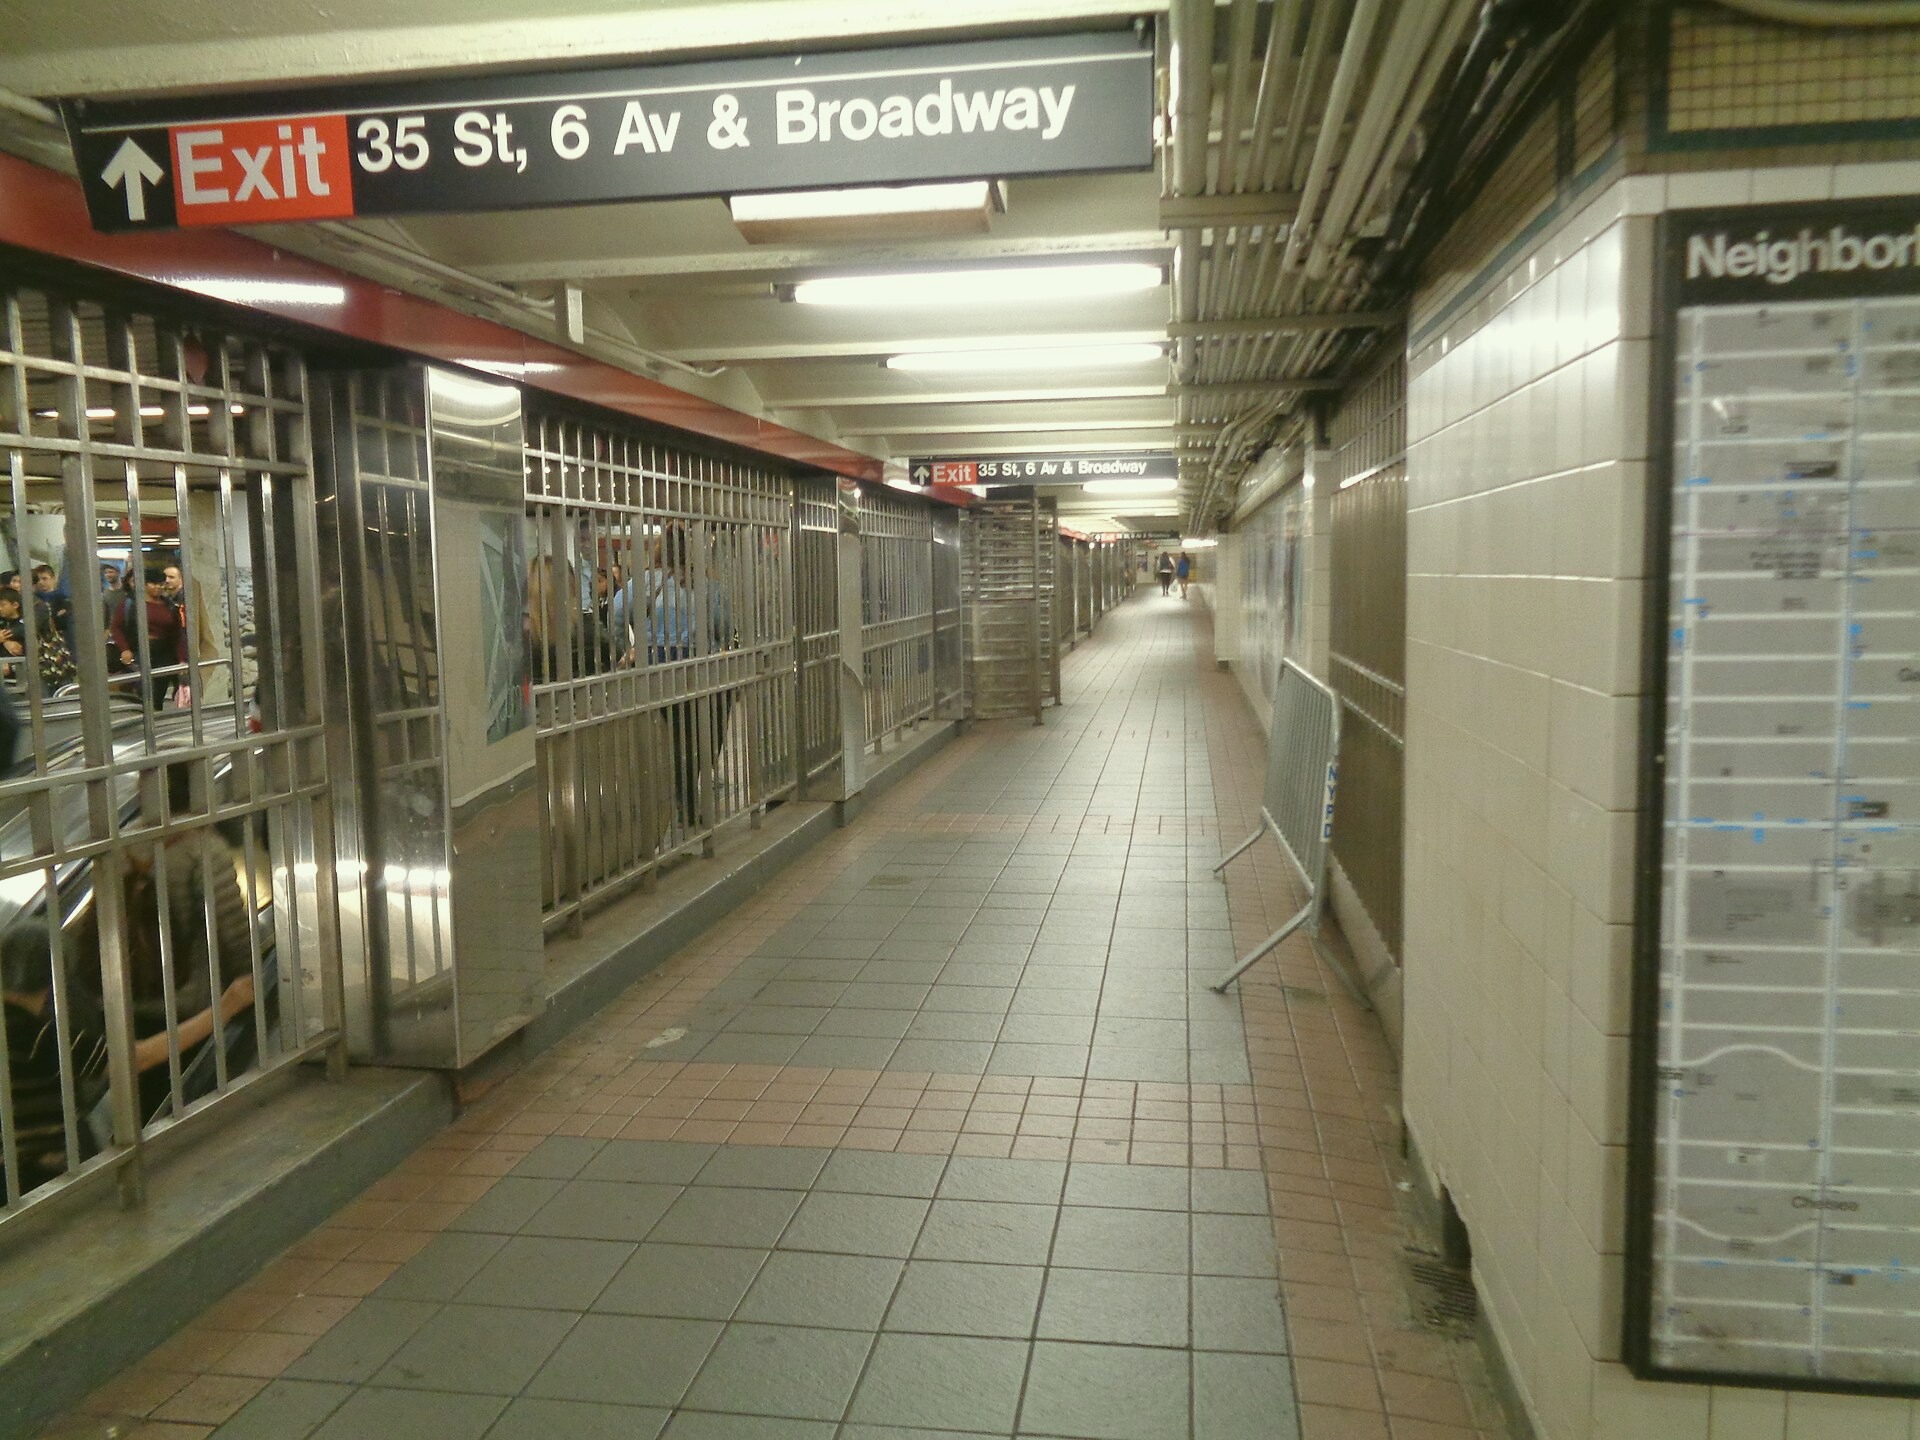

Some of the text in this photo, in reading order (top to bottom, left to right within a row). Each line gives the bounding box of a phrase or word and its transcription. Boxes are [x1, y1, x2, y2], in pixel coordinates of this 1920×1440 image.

[175, 78, 1076, 205] Exit 35 St, 6 Av & Broadway
[1686, 222, 1920, 284] Neighbor
[932, 460, 1147, 483] Exit 35 St, 6 Av & Broadway
[1323, 764, 1338, 839] NYPD
